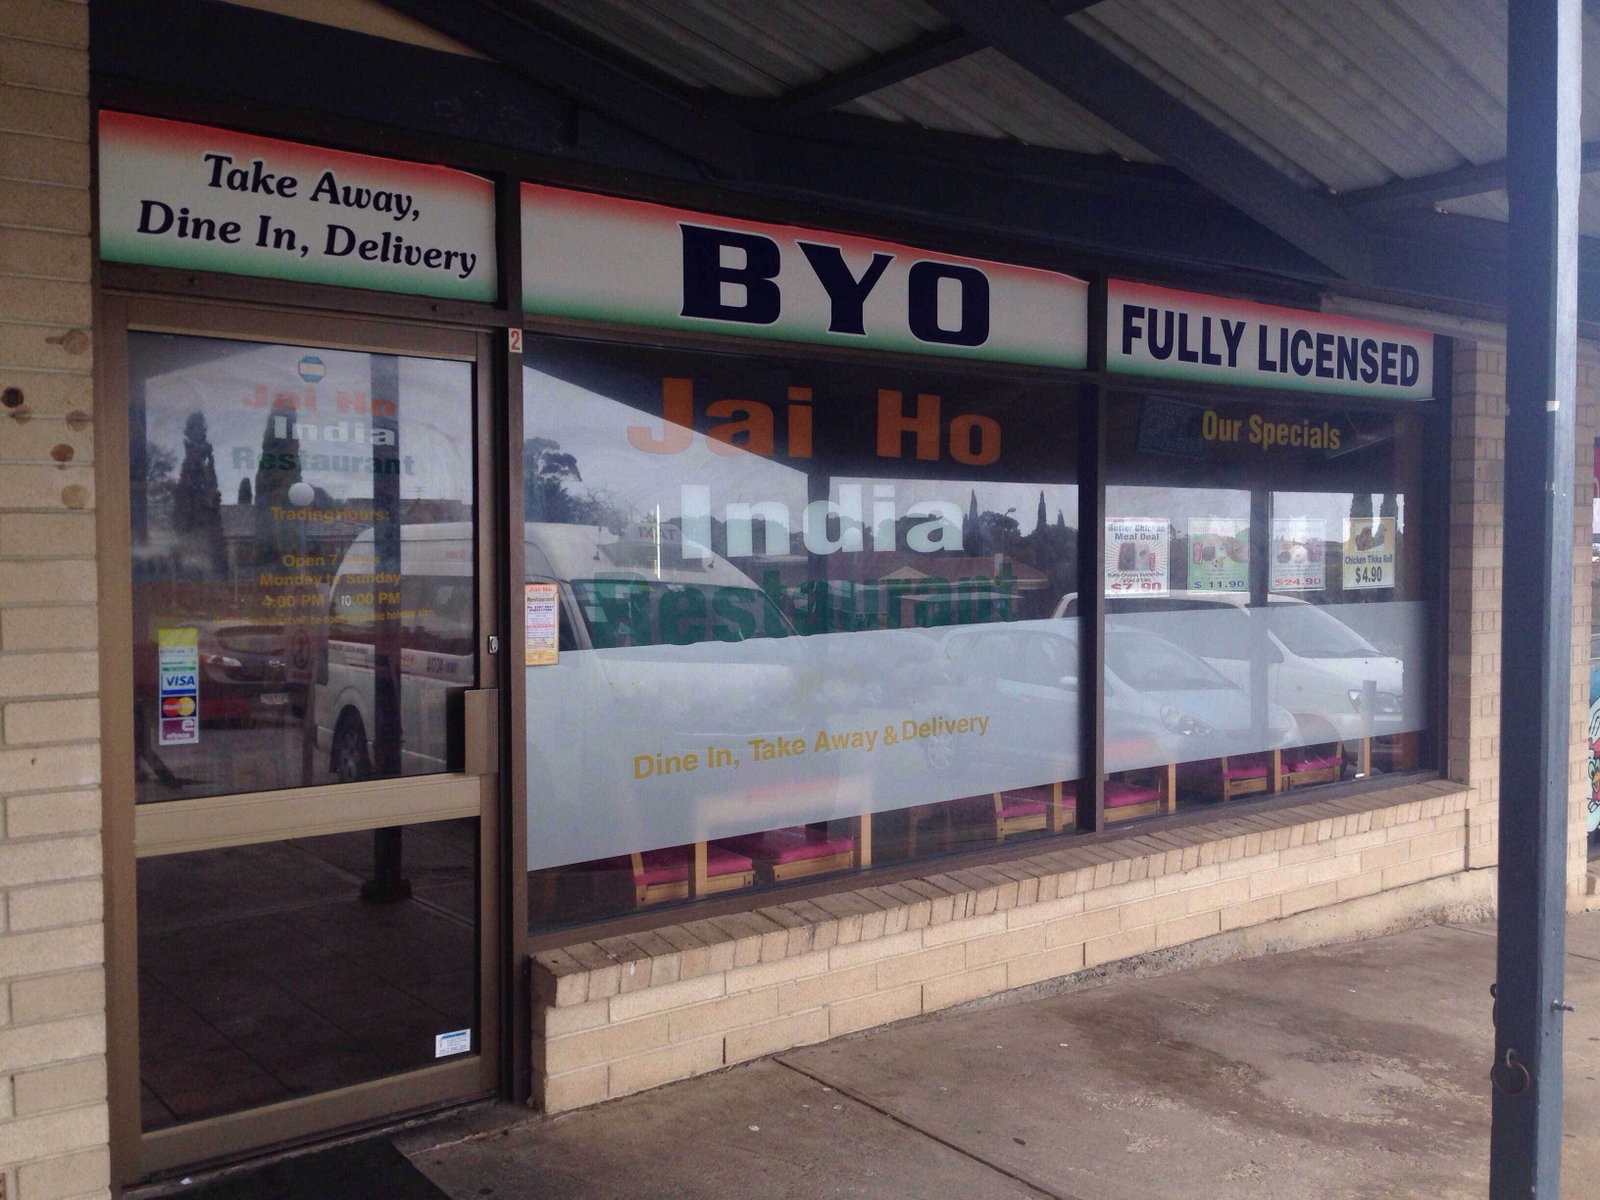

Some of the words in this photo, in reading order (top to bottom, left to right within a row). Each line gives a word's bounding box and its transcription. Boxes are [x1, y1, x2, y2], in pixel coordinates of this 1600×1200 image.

[204, 154, 298, 198] Take
[310, 172, 420, 222] Away,
[137, 200, 241, 244] Dine
[255, 215, 309, 257] In,
[324, 224, 477, 279] Delivery
[677, 222, 990, 347] BYO
[511, 330, 520, 351] 2
[1122, 304, 1246, 368] FULLY
[1259, 324, 1420, 387] LICENSED
[242, 384, 317, 411] Jai
[336, 391, 396, 417] Ho
[274, 415, 396, 446] India
[627, 378, 813, 458] Jai
[876, 389, 1001, 466] Ho
[1203, 409, 1243, 442] Our
[1249, 414, 1341, 450] Specials
[231, 446, 415, 476] Restaurant
[270, 506, 334, 523] Trading
[681, 484, 965, 559] India
[1135, 524, 1166, 532] Chicen
[282, 554, 325, 568] Open
[329, 555, 337, 565] 7
[1345, 555, 1366, 565] Chicken
[1355, 566, 1383, 584] $4.90
[259, 573, 323, 586] Monday
[347, 572, 400, 585] Sunday
[1111, 582, 1162, 591] $790
[1275, 578, 1321, 586] $24.90
[302, 594, 325, 607] PM
[379, 592, 401, 605] PM
[593, 561, 1018, 648] Restaurant
[166, 675, 195, 686] VISA
[633, 752, 699, 779] Dine
[708, 746, 740, 769] In,
[748, 736, 806, 761] Take
[814, 727, 878, 753] Away
[882, 725, 899, 746] &
[902, 715, 990, 742] Delivery
